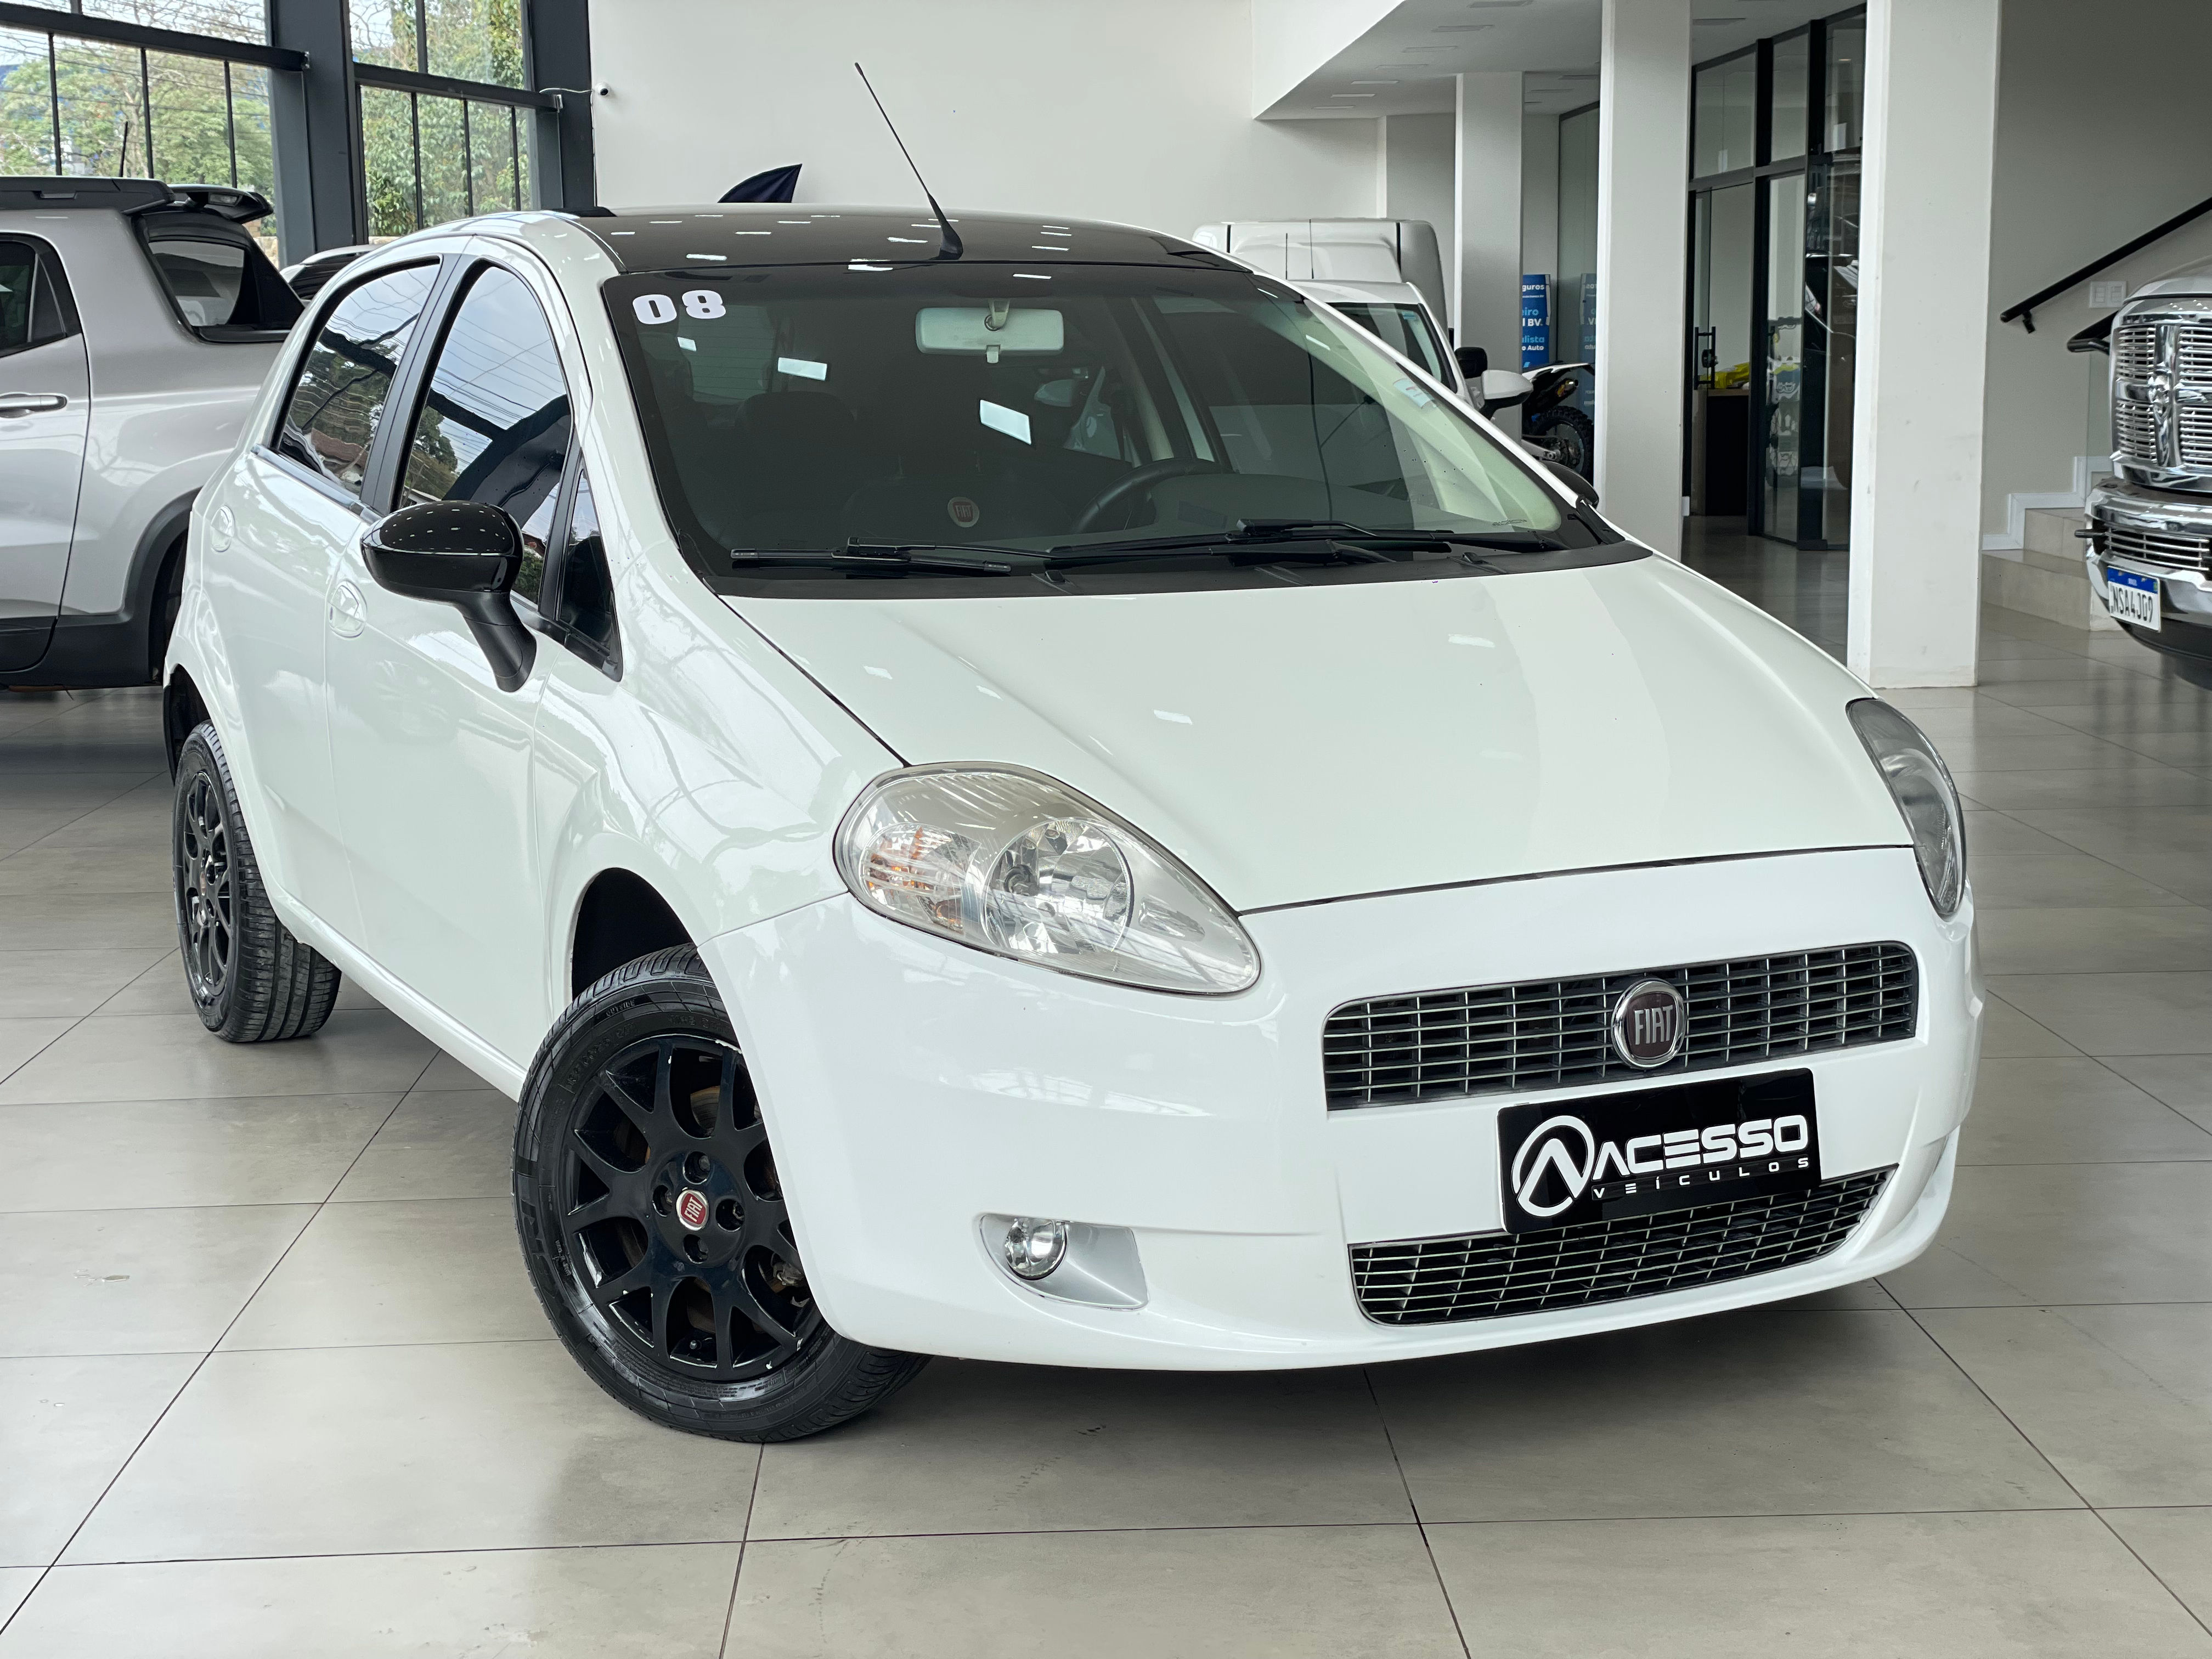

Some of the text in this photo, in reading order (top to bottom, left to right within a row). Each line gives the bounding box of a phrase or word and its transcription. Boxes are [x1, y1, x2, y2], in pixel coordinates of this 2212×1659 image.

[632, 290, 726, 325] 08
[955, 505, 972, 518] FIAT
[1634, 1005, 1673, 1046] FIAT
[1592, 1115, 1809, 1180] ACESSO
[684, 1196, 703, 1223] FIAT
